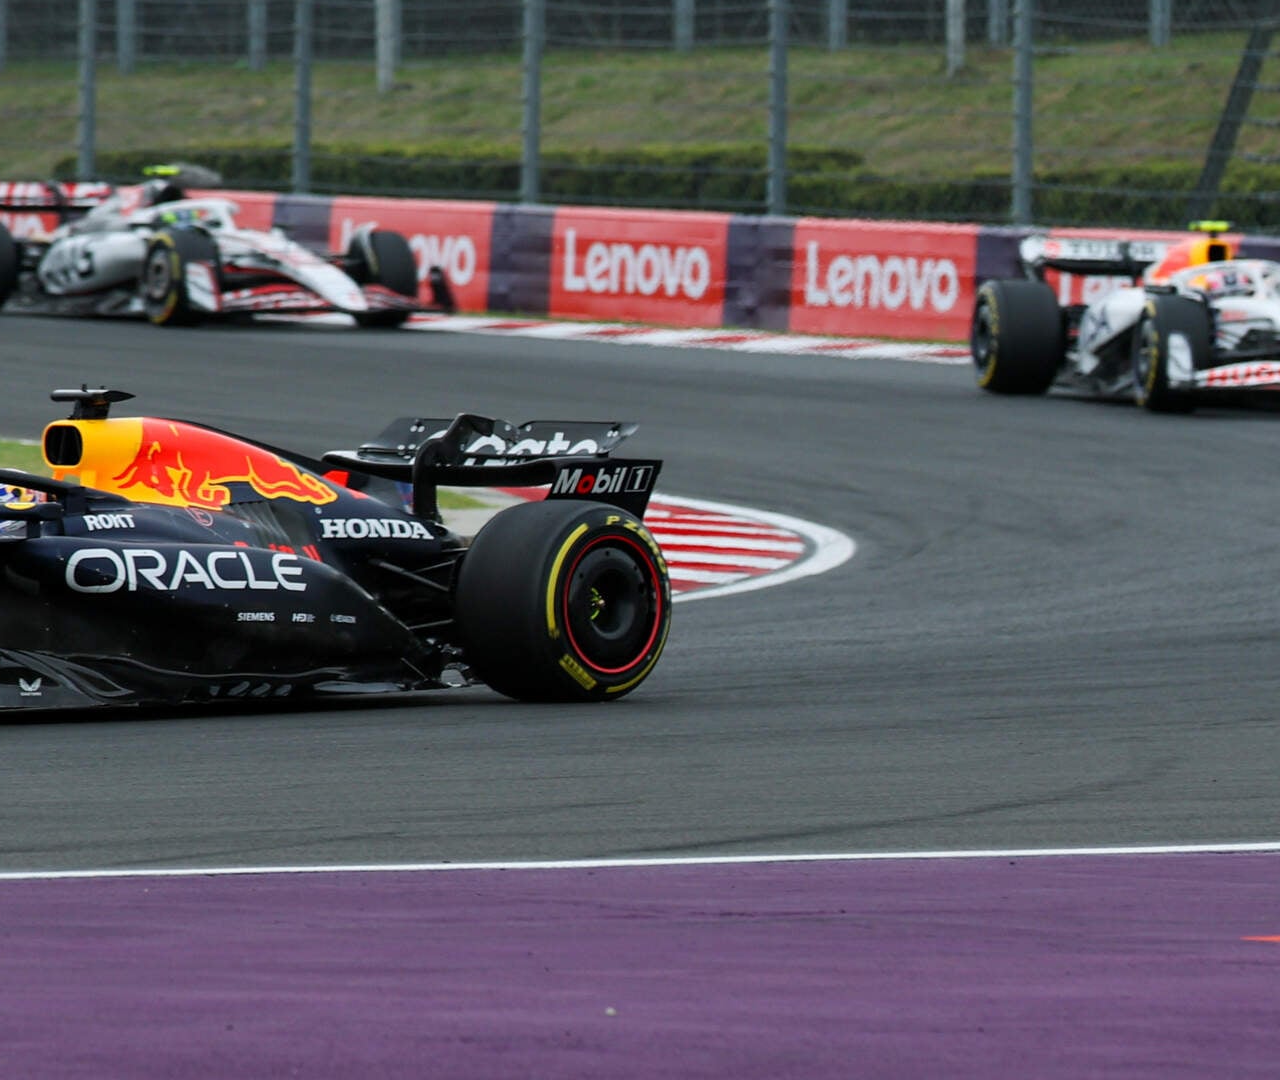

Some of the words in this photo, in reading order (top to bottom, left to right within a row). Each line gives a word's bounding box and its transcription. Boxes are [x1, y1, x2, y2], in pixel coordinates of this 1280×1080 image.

[563, 228, 710, 300] Lenovo
[805, 241, 960, 313] Lenovo
[552, 467, 628, 495] Mobil
[633, 468, 646, 490] 1
[320, 518, 434, 540] HONDA
[65, 548, 307, 593] ORACLE
[237, 612, 276, 622] SIEMENS
